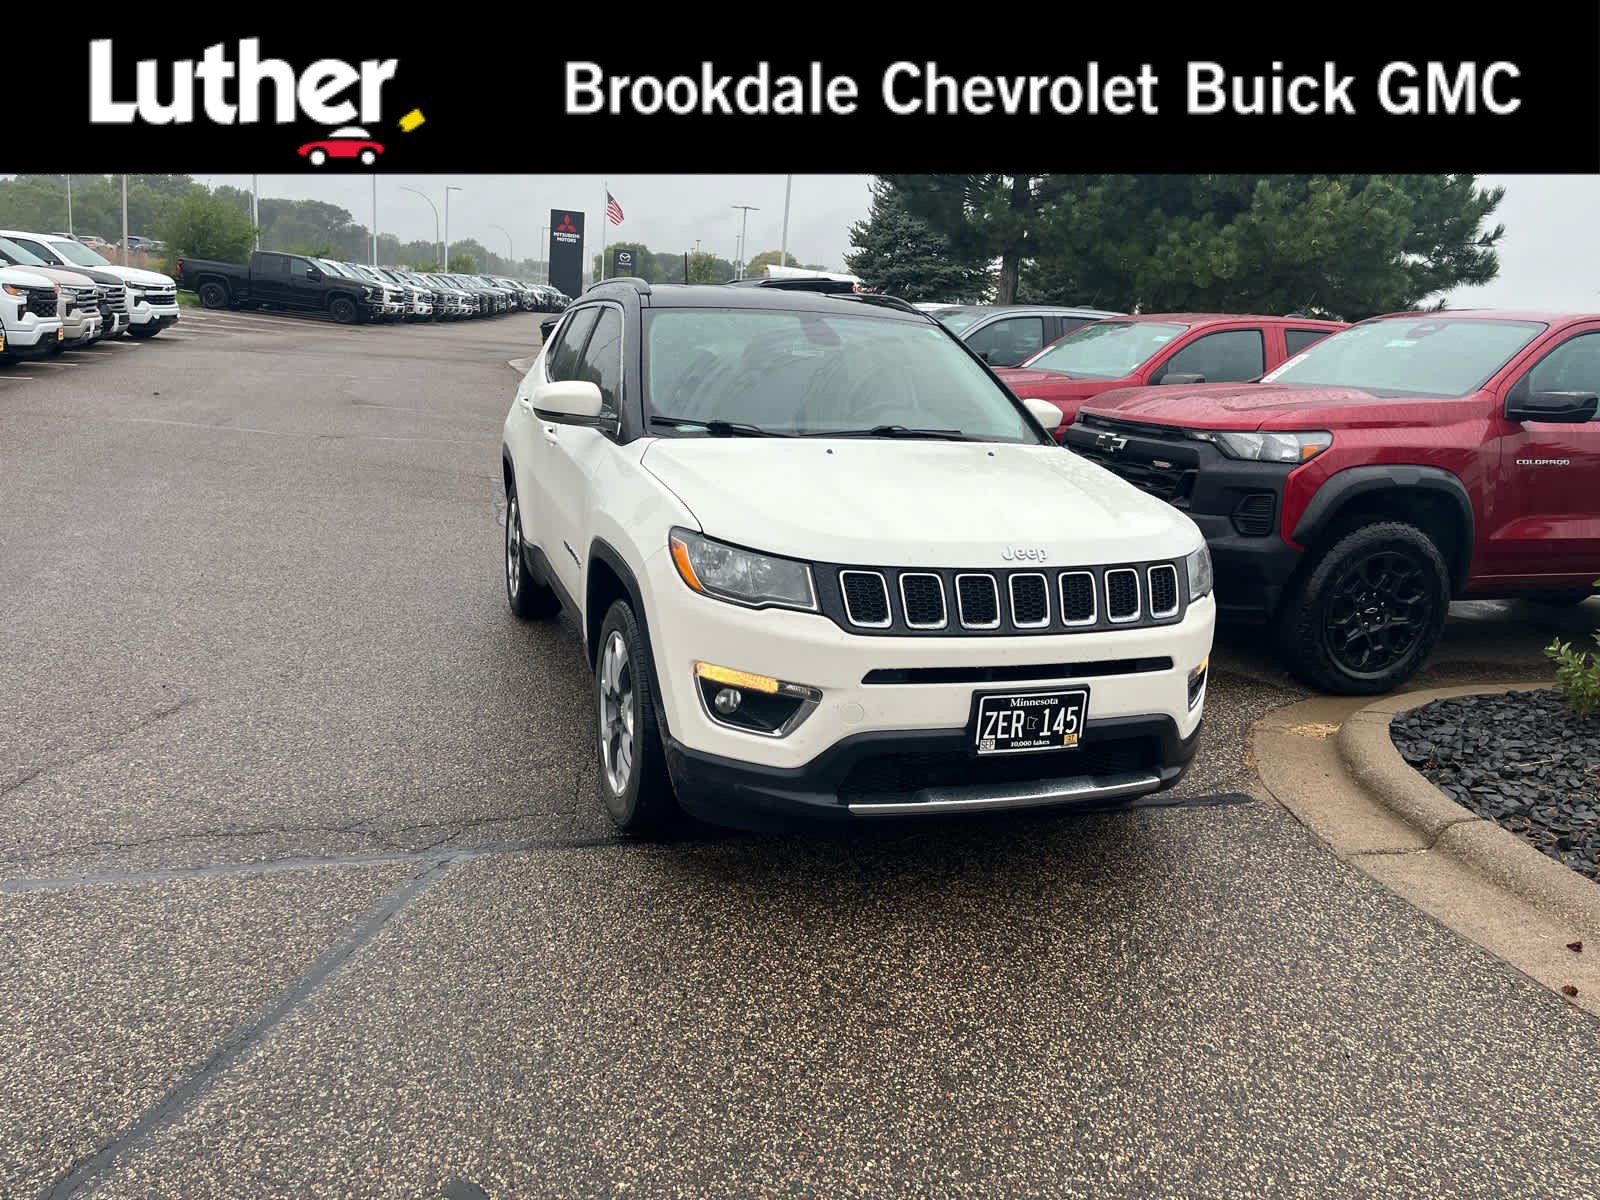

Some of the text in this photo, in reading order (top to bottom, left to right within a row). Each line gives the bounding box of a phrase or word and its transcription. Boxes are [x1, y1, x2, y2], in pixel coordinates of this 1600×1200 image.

[1001, 544, 1048, 563] Jeep
[1010, 698, 1058, 707] Minnesota
[983, 706, 1078, 739] ZER 145
